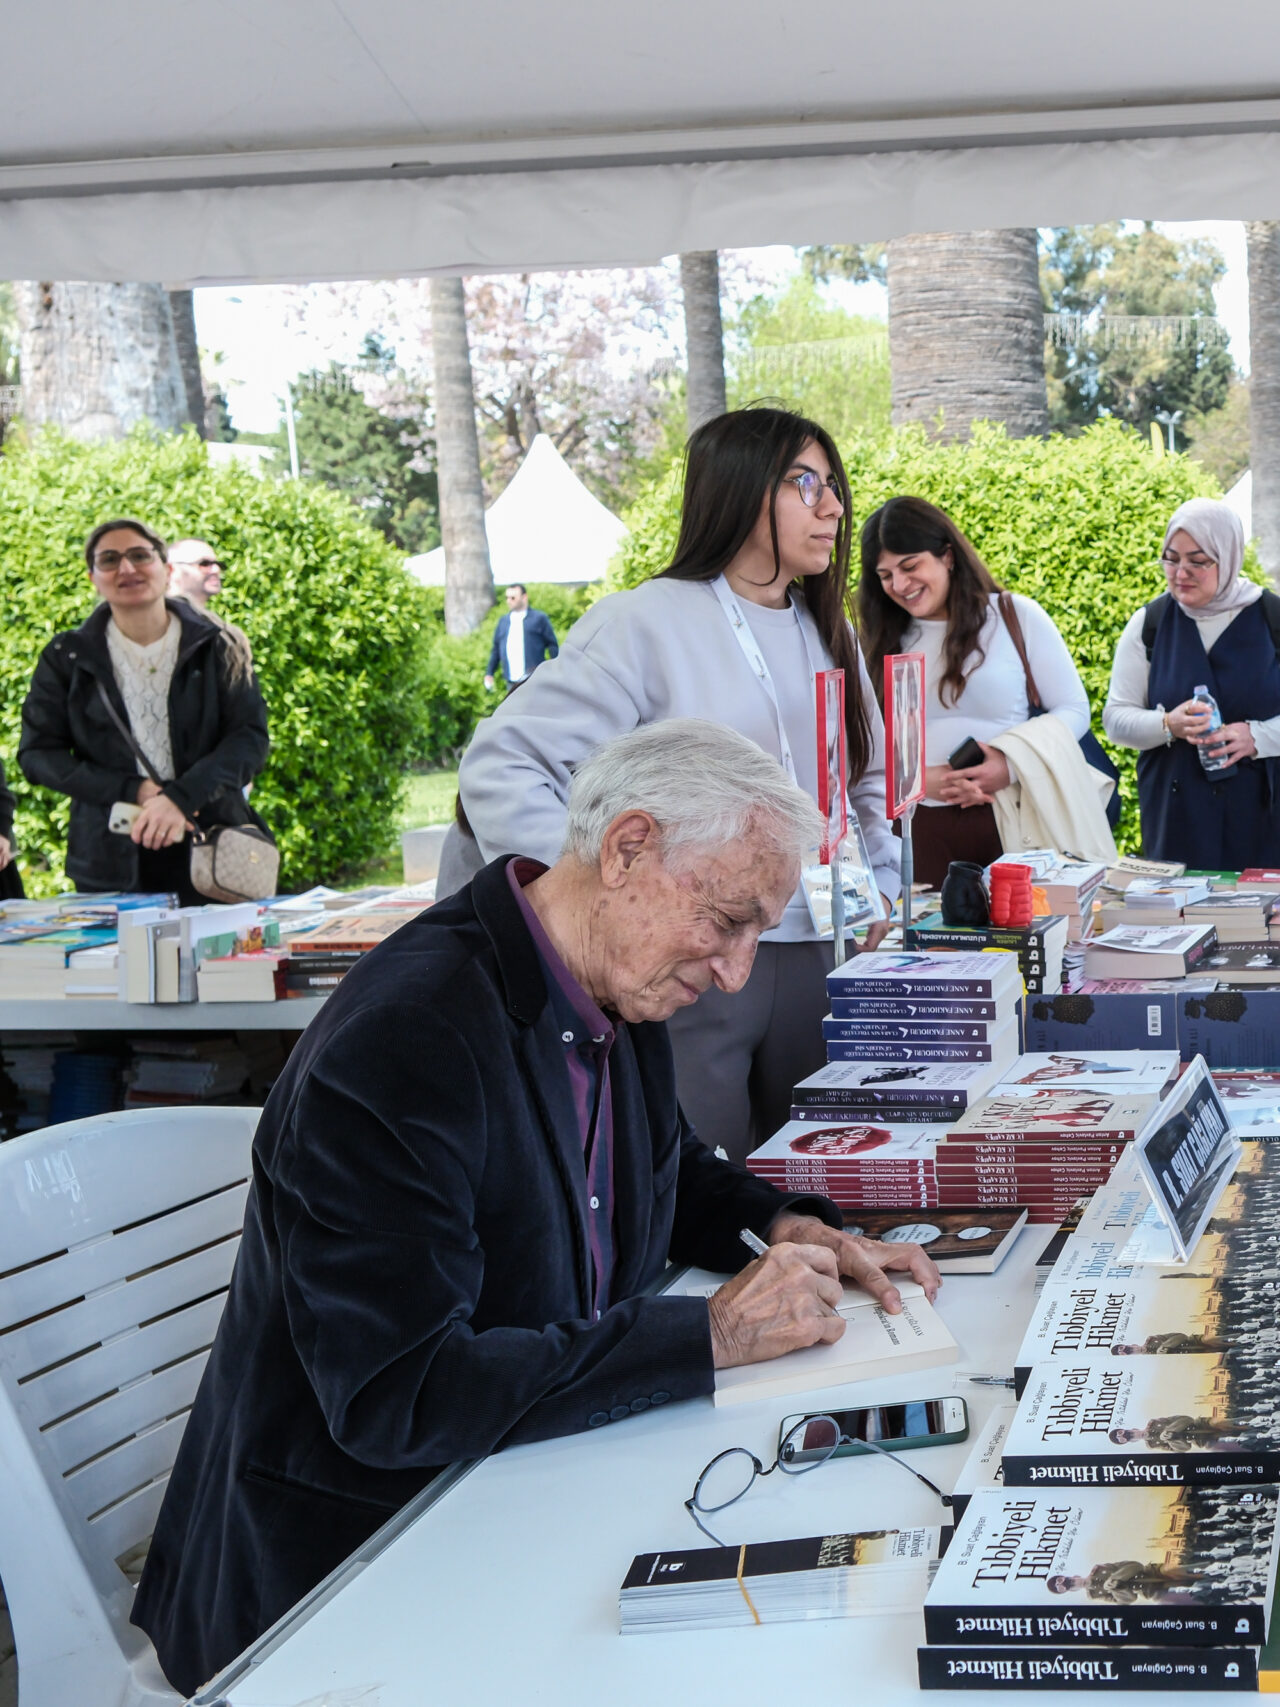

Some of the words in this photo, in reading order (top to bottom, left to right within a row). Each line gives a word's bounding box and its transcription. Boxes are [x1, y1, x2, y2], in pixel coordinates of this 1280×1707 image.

[910, 1028, 944, 1036] FAKHOURI
[945, 1028, 965, 1036] ANNE
[1187, 1098, 1225, 1172] ÇAĞLAYAN
[1171, 1139, 1200, 1194] SUAT
[1162, 1170, 1184, 1208] B.
[1051, 1288, 1100, 1356] Tıbbiyeli
[1085, 1292, 1127, 1349] Hikmet
[1041, 1366, 1095, 1442] Tıbbiyeli
[1079, 1370, 1124, 1434] Hikmet
[1029, 1465, 1099, 1483] Hikmet
[1102, 1459, 1184, 1482] Tıbbiyeli
[1195, 1464, 1233, 1476] Çağlayan
[1234, 1466, 1253, 1475] Suat
[1254, 1466, 1264, 1475] B.
[971, 1499, 1038, 1590] Tıbbiyeli
[1014, 1505, 1072, 1582] Hikmet
[956, 1617, 1034, 1636] Hikmet
[1037, 1611, 1129, 1637] Tıbbiyeli
[1142, 1618, 1184, 1631] Çağlayan
[1185, 1621, 1206, 1630] Suat
[1208, 1621, 1218, 1630] B.
[947, 1659, 1024, 1680] Hikmet
[1028, 1654, 1119, 1681] Tıbbiyeli
[1132, 1661, 1174, 1675] Çağlayan
[1175, 1664, 1196, 1674] Suat
[1199, 1664, 1209, 1674] B.
